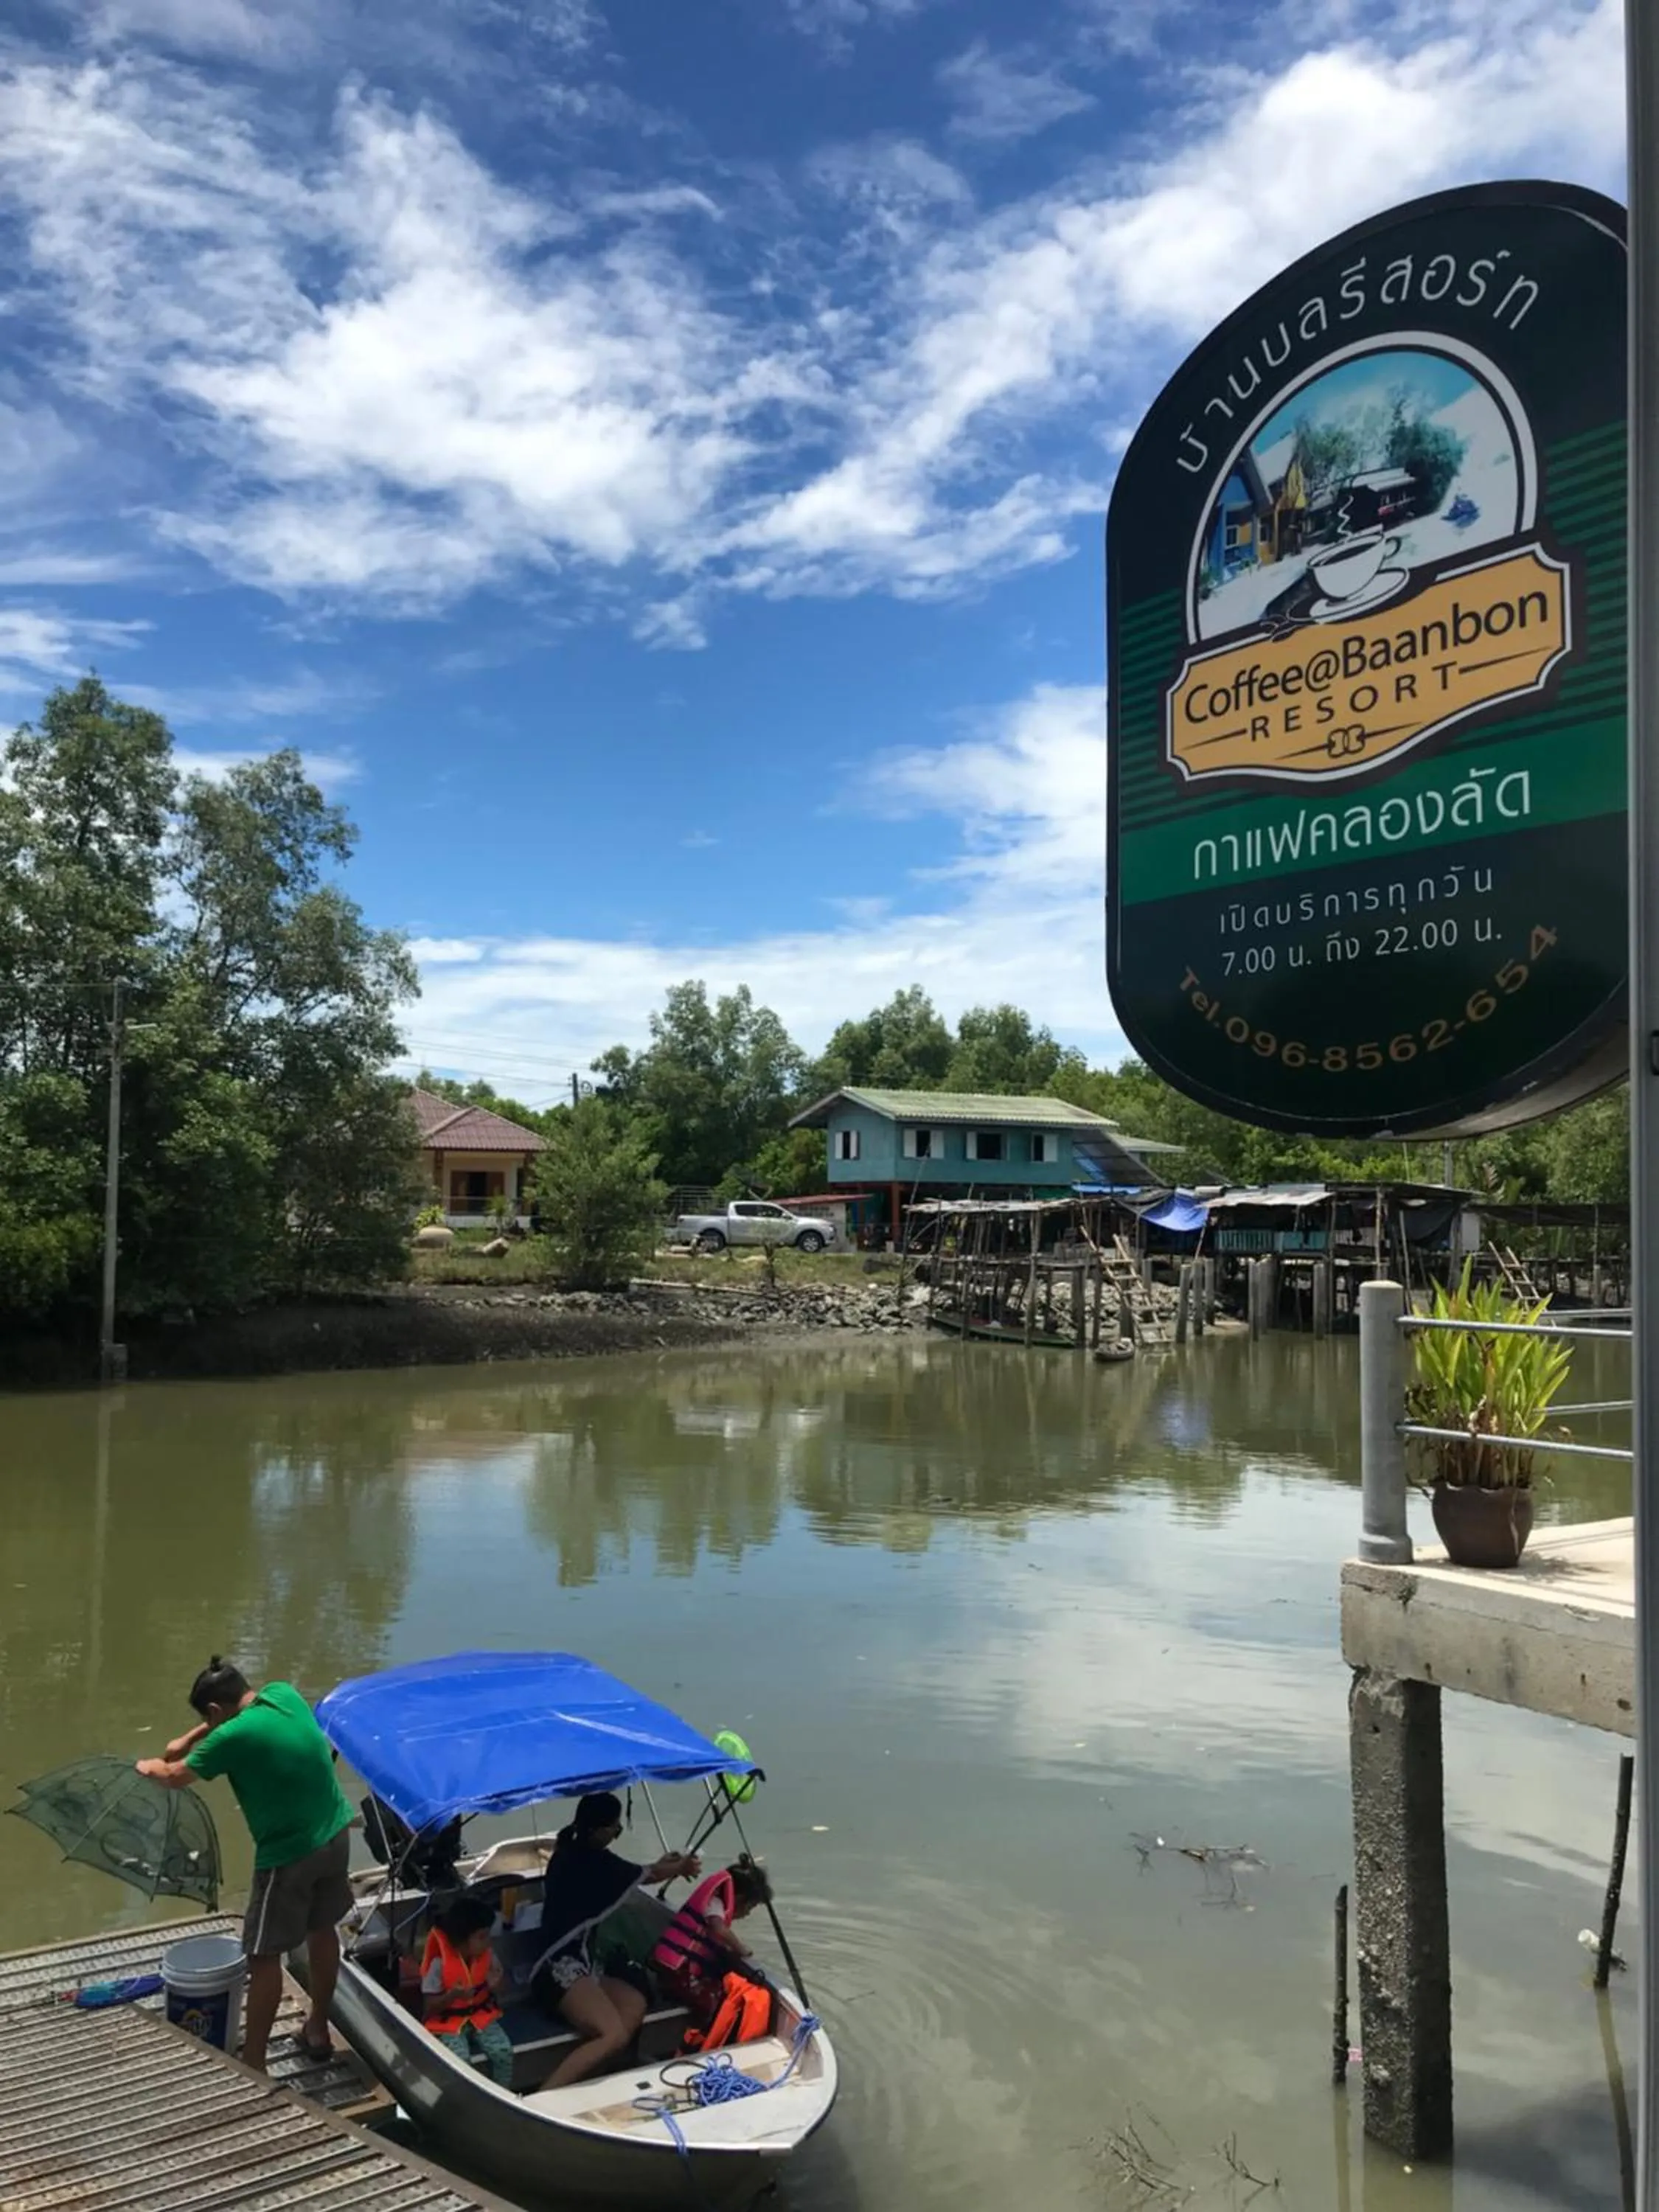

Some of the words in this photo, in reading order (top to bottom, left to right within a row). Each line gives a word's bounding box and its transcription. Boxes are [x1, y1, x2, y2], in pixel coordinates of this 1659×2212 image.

[1185, 591, 1548, 724] Coffee@Baanbon
[1251, 661, 1458, 741] RESORT
[1194, 767, 1531, 880] กาแฟคลองลัด
[1222, 946, 1275, 976] 7.00
[1289, 945, 1312, 967] น.
[1326, 931, 1360, 962] ถึง
[1375, 919, 1458, 956] 22.00
[1475, 918, 1502, 942] น.
